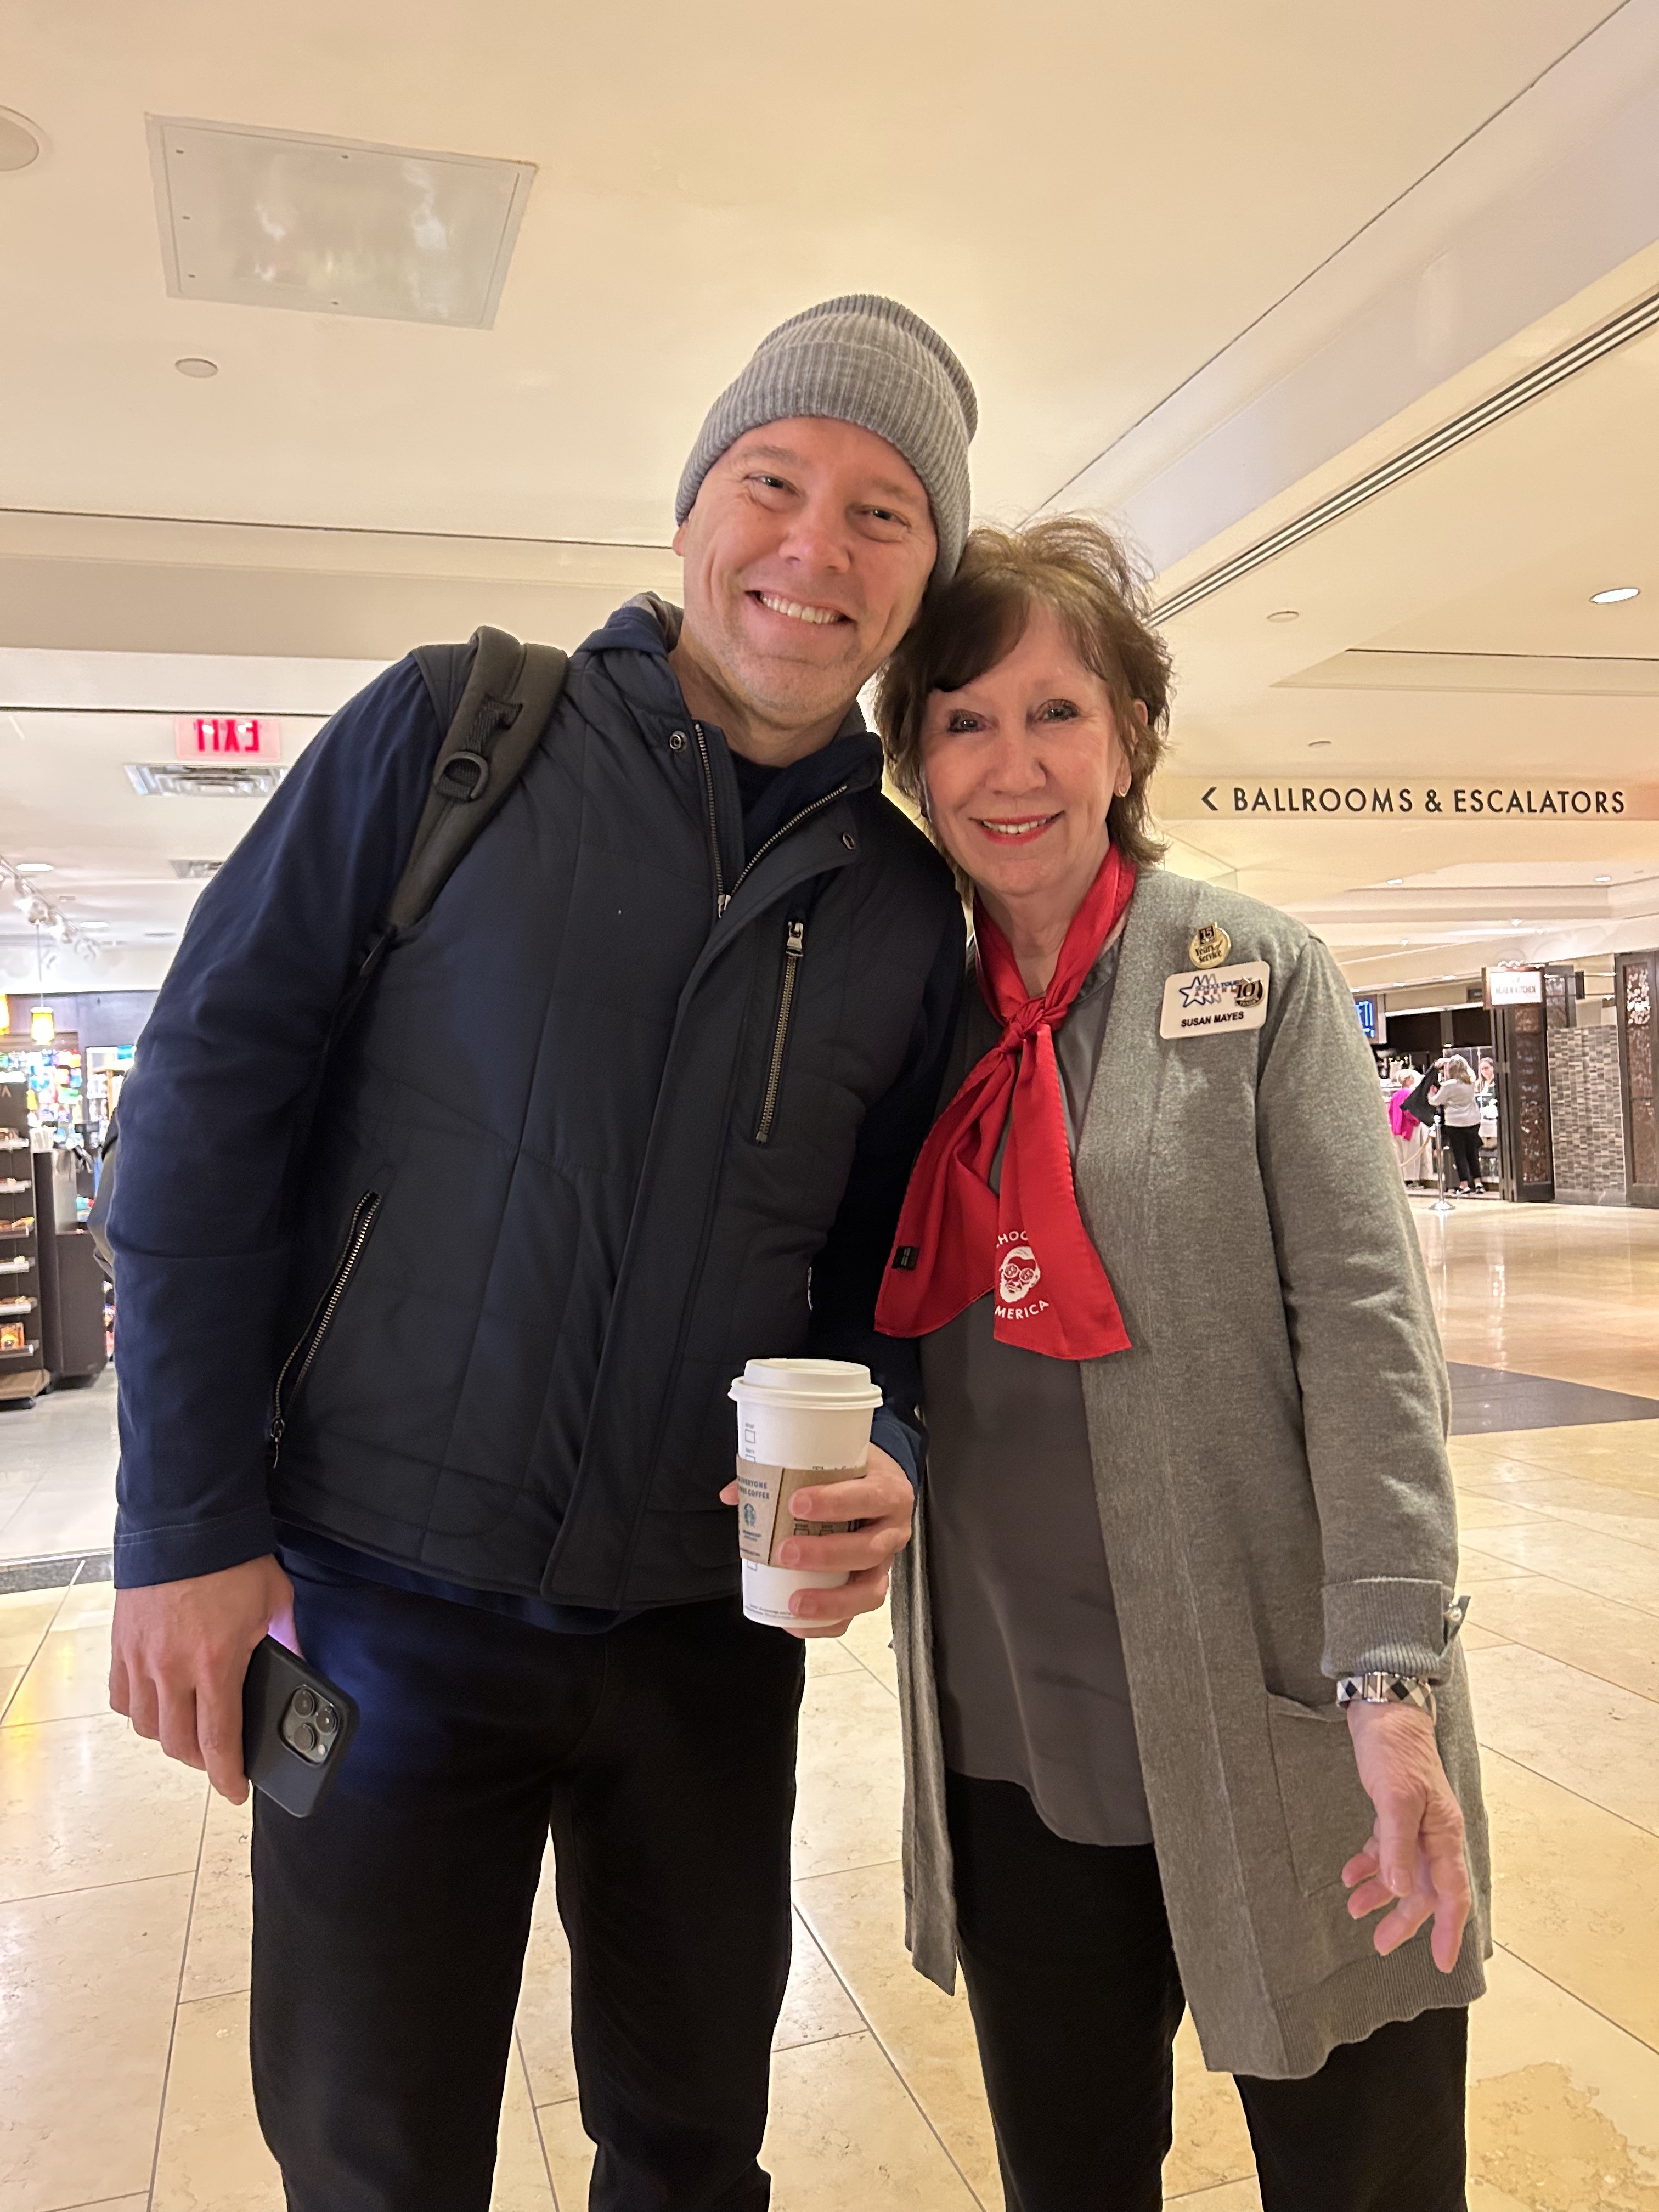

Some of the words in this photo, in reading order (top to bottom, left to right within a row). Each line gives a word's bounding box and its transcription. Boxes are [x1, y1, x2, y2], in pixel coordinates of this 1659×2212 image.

[1233, 786, 1413, 812] BALLROOMS
[1425, 789, 1443, 813] &
[1454, 789, 1624, 814] ESCALATORS
[1237, 982, 1256, 998] 10
[1181, 1015, 1211, 1027] SUSAN
[1214, 1011, 1244, 1023] MAYES
[748, 1489, 770, 1499] COFFEE
